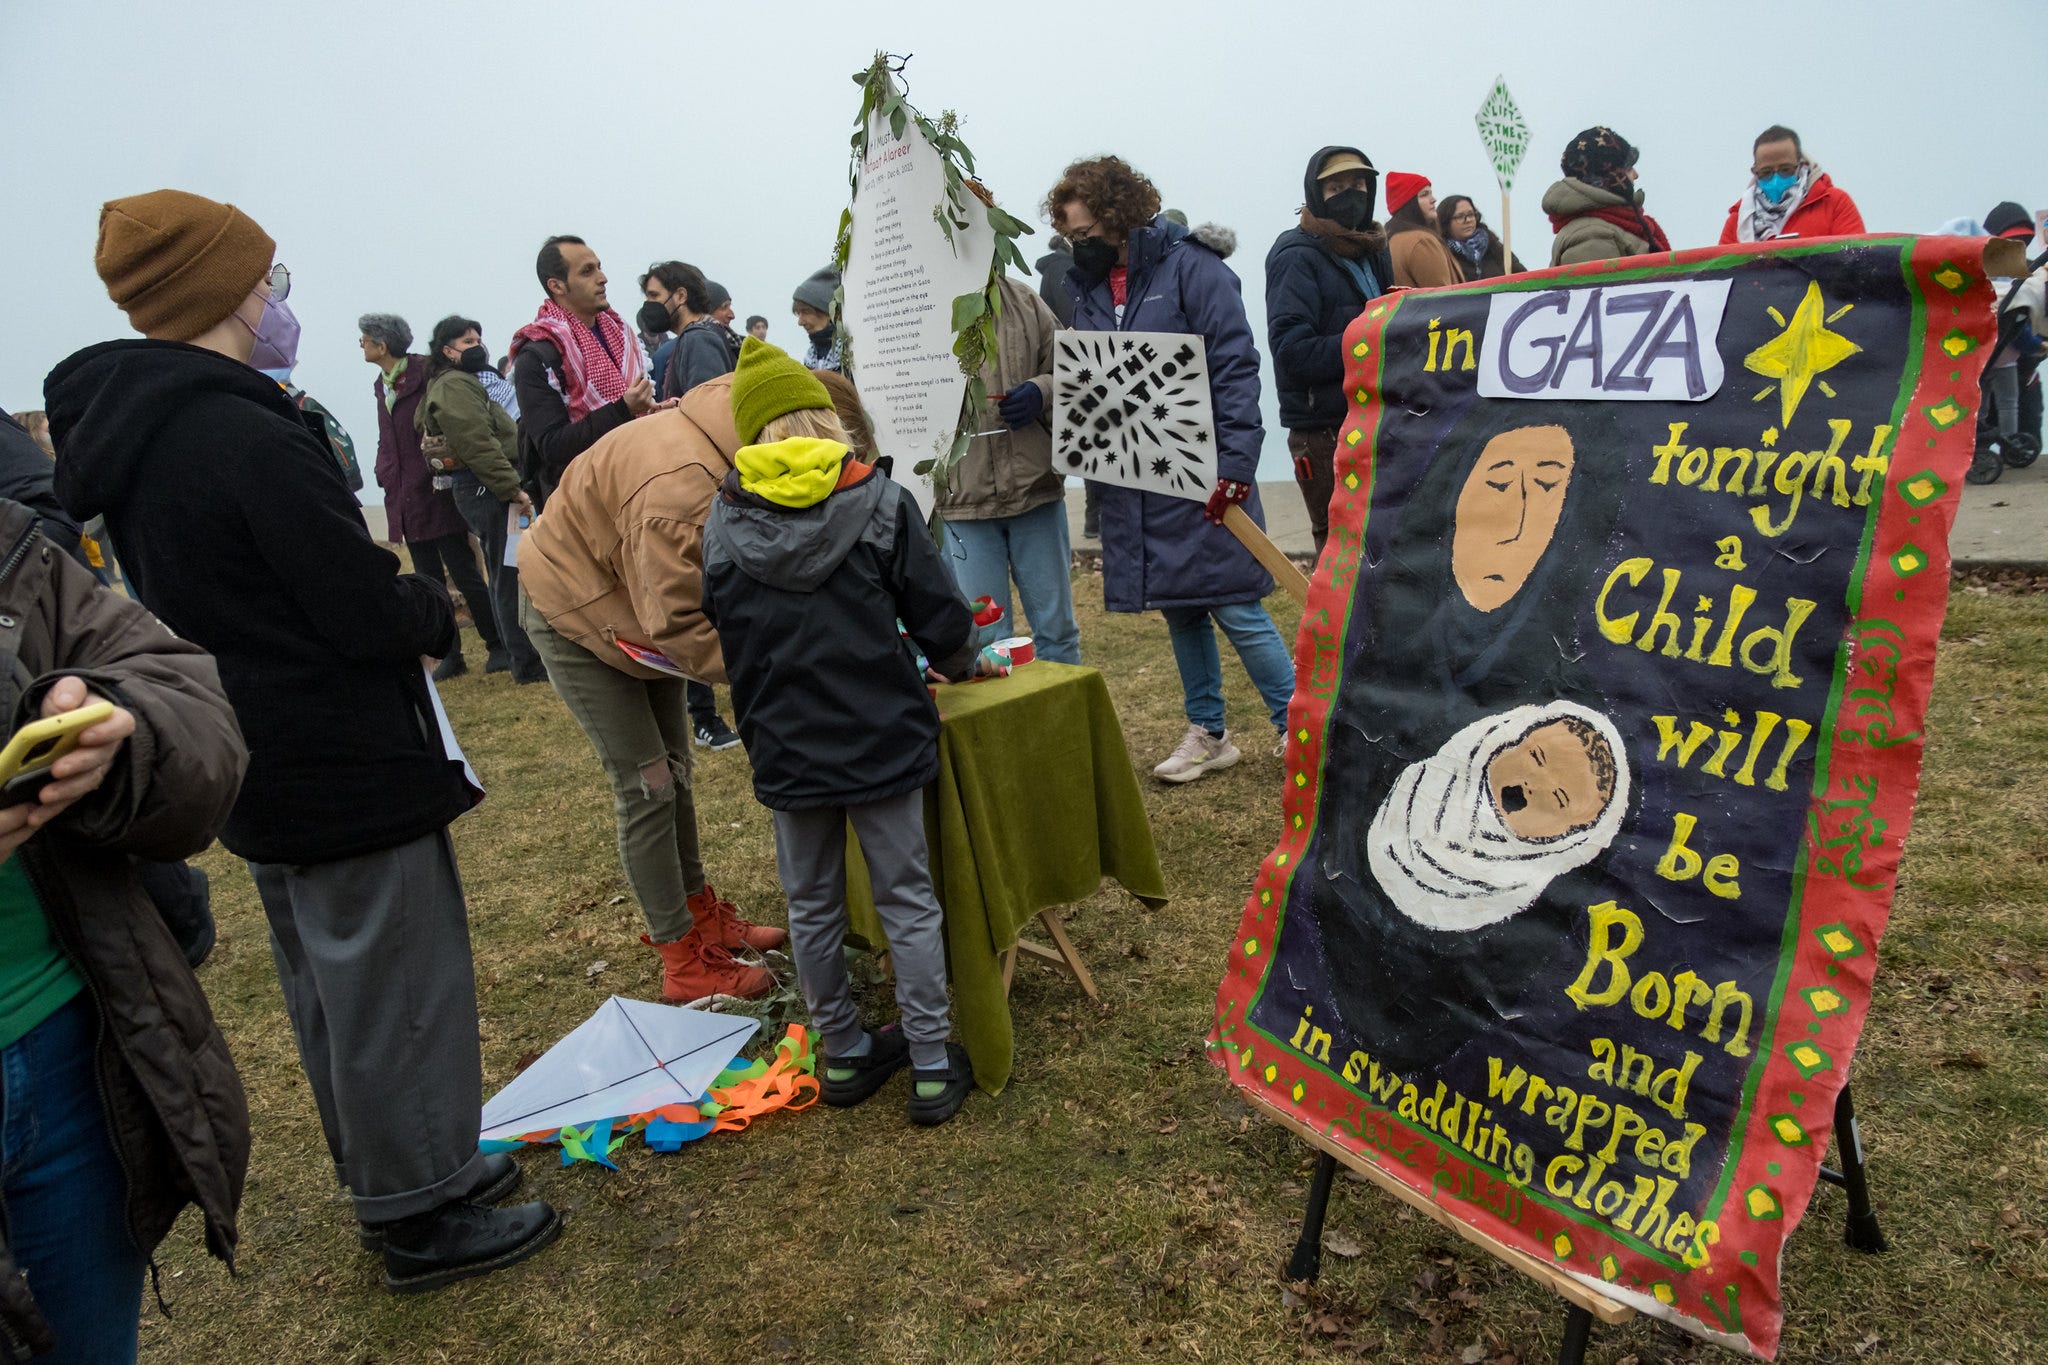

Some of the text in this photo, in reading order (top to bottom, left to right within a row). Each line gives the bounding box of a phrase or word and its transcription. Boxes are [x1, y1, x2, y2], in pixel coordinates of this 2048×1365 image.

[882, 143, 912, 164] Alareer
[1491, 104, 1514, 121] LIFT
[1494, 123, 1515, 138] THE
[921, 377, 933, 387] angel
[927, 353, 941, 362] flying
[943, 352, 950, 360] up
[1424, 288, 1706, 398] in GAZA
[886, 394, 905, 402] bringing
[903, 416, 915, 424] bring
[1066, 343, 1196, 467] OCCUPATION
[1067, 342, 1158, 428] END THE
[1650, 419, 1891, 537] tonight
[1715, 536, 1746, 571] a
[1595, 558, 1816, 689] Child
[1652, 708, 1813, 791] will
[1655, 813, 1741, 899] be
[1565, 900, 1758, 1058] Born
[1289, 1005, 1333, 1065] in
[1342, 1052, 1535, 1185] swaddling
[1487, 1056, 1706, 1179] wrapped
[1589, 1037, 1703, 1119] and
